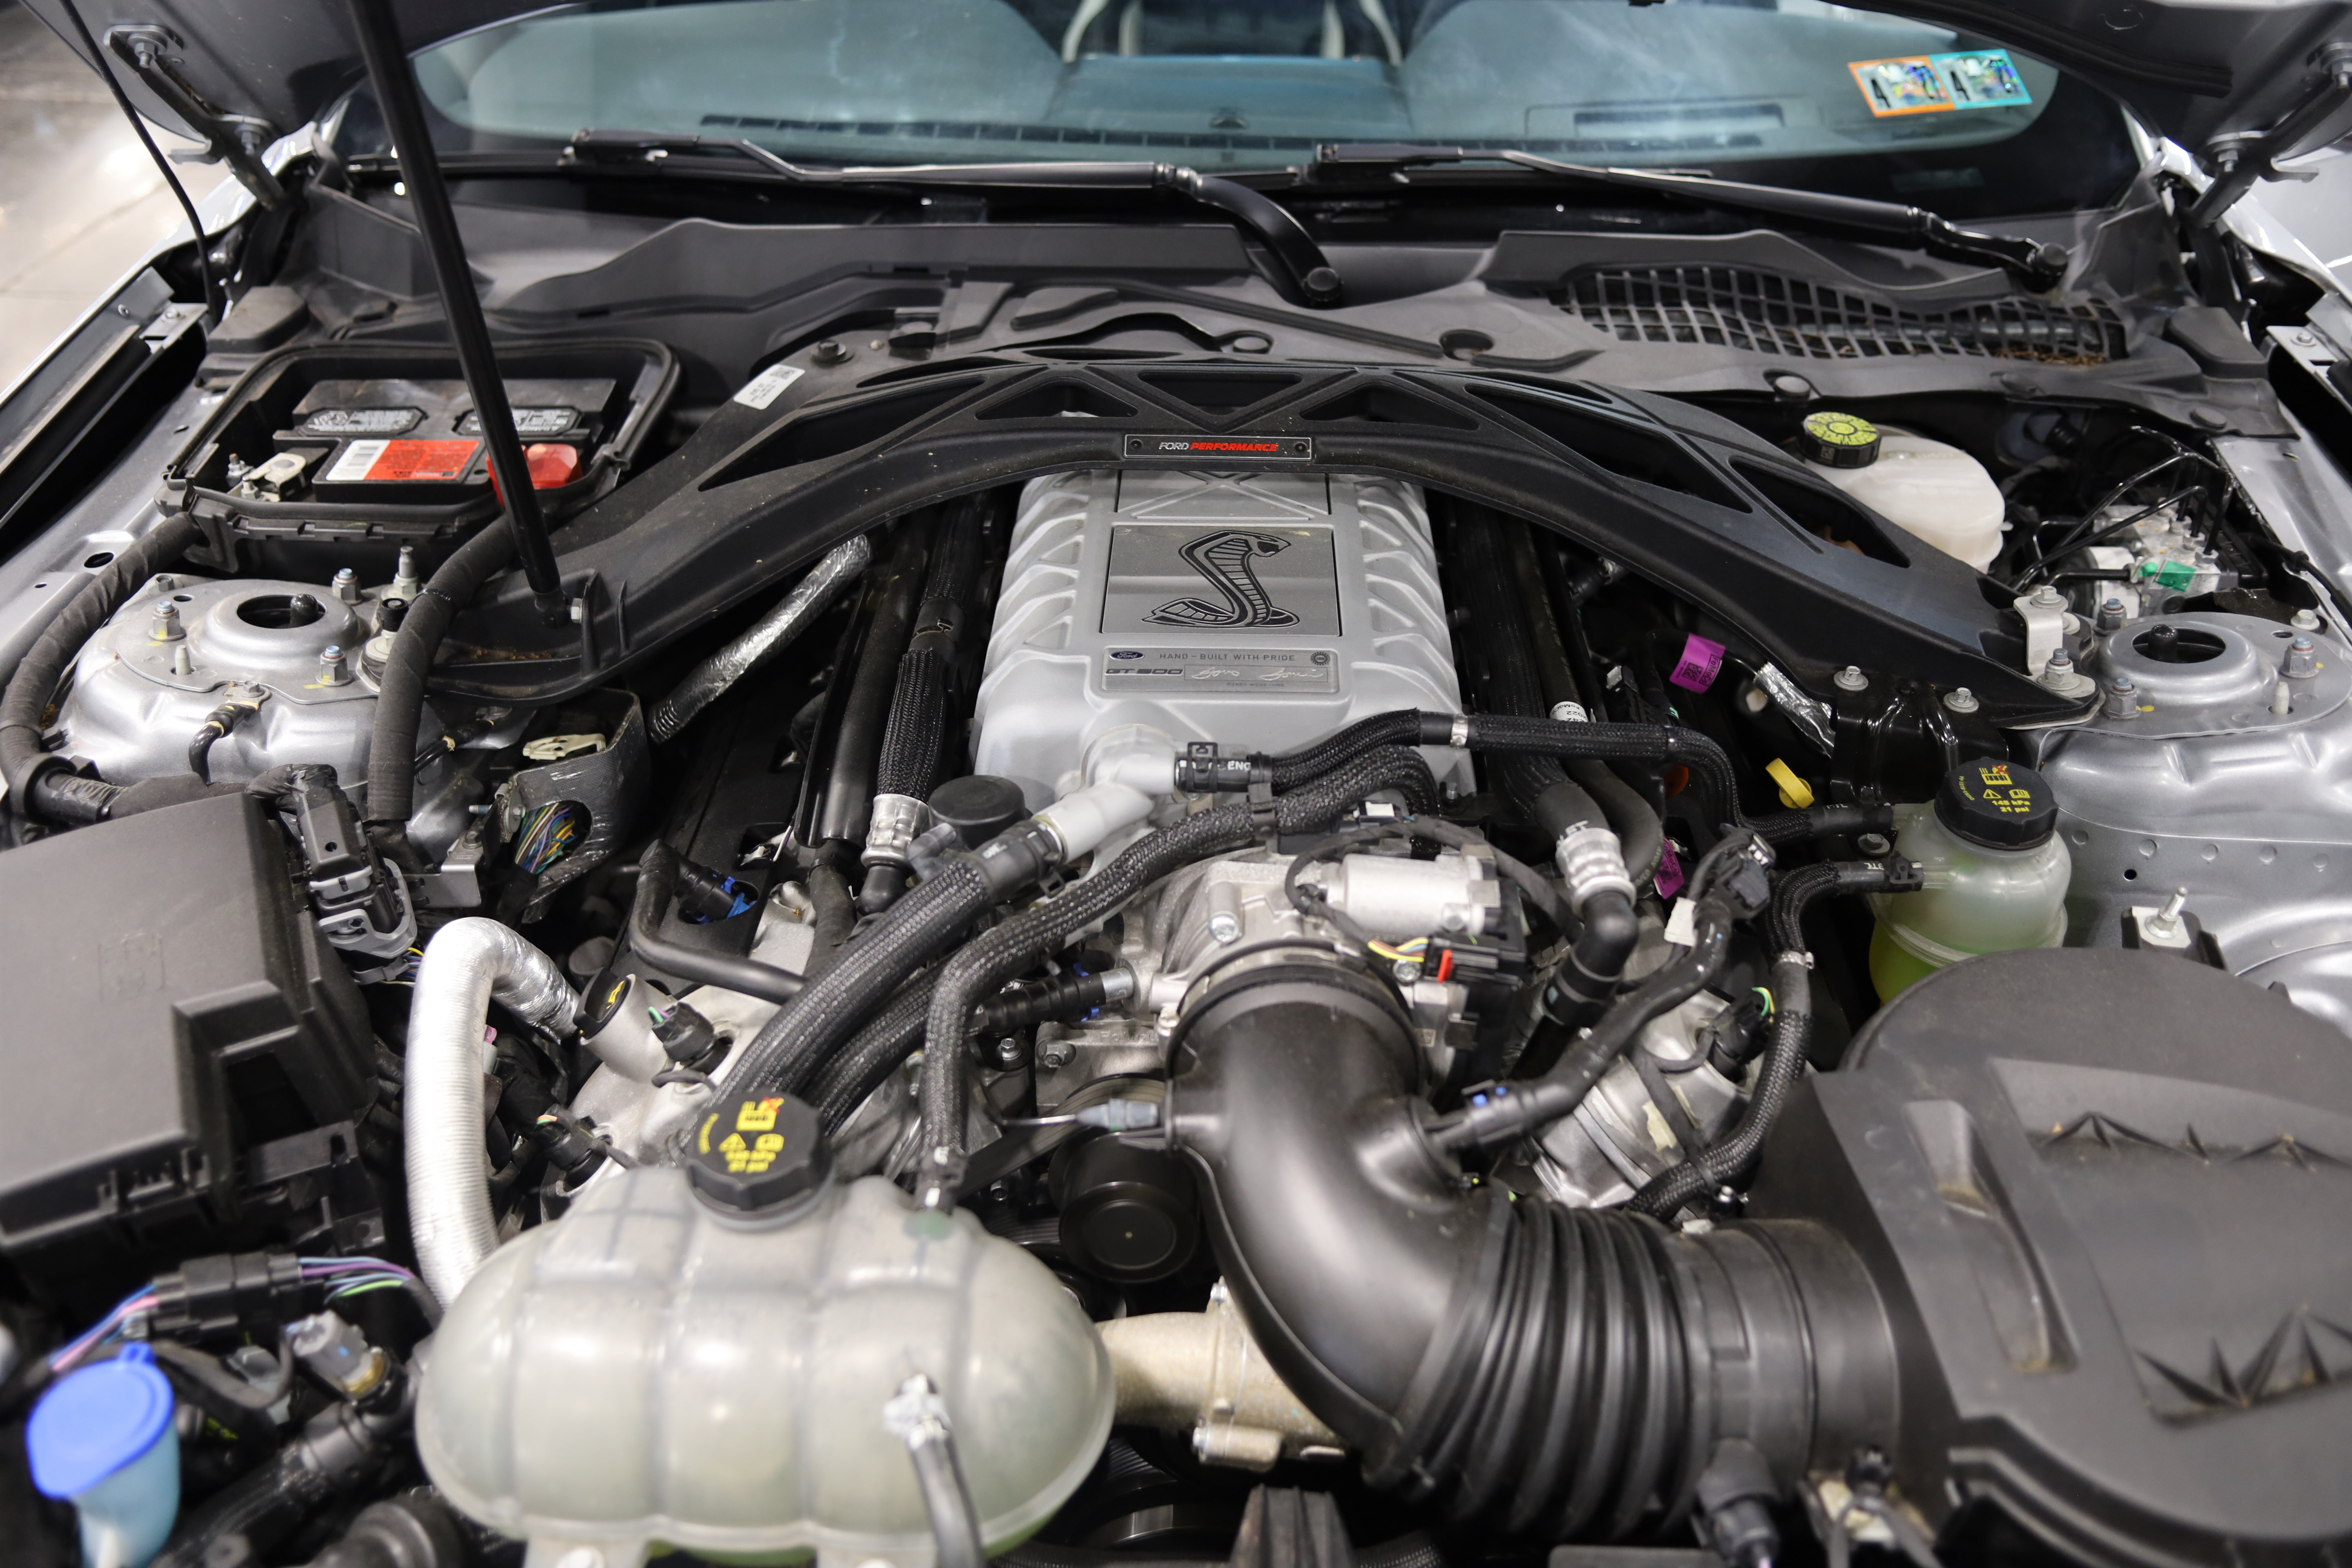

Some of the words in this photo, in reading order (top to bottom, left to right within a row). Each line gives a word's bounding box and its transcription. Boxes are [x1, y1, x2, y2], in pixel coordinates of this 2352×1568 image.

[1158, 442, 1189, 450] FORD
[1190, 442, 1278, 452] PERFORMANCE
[1701, 656, 1718, 684] FoMoCo
